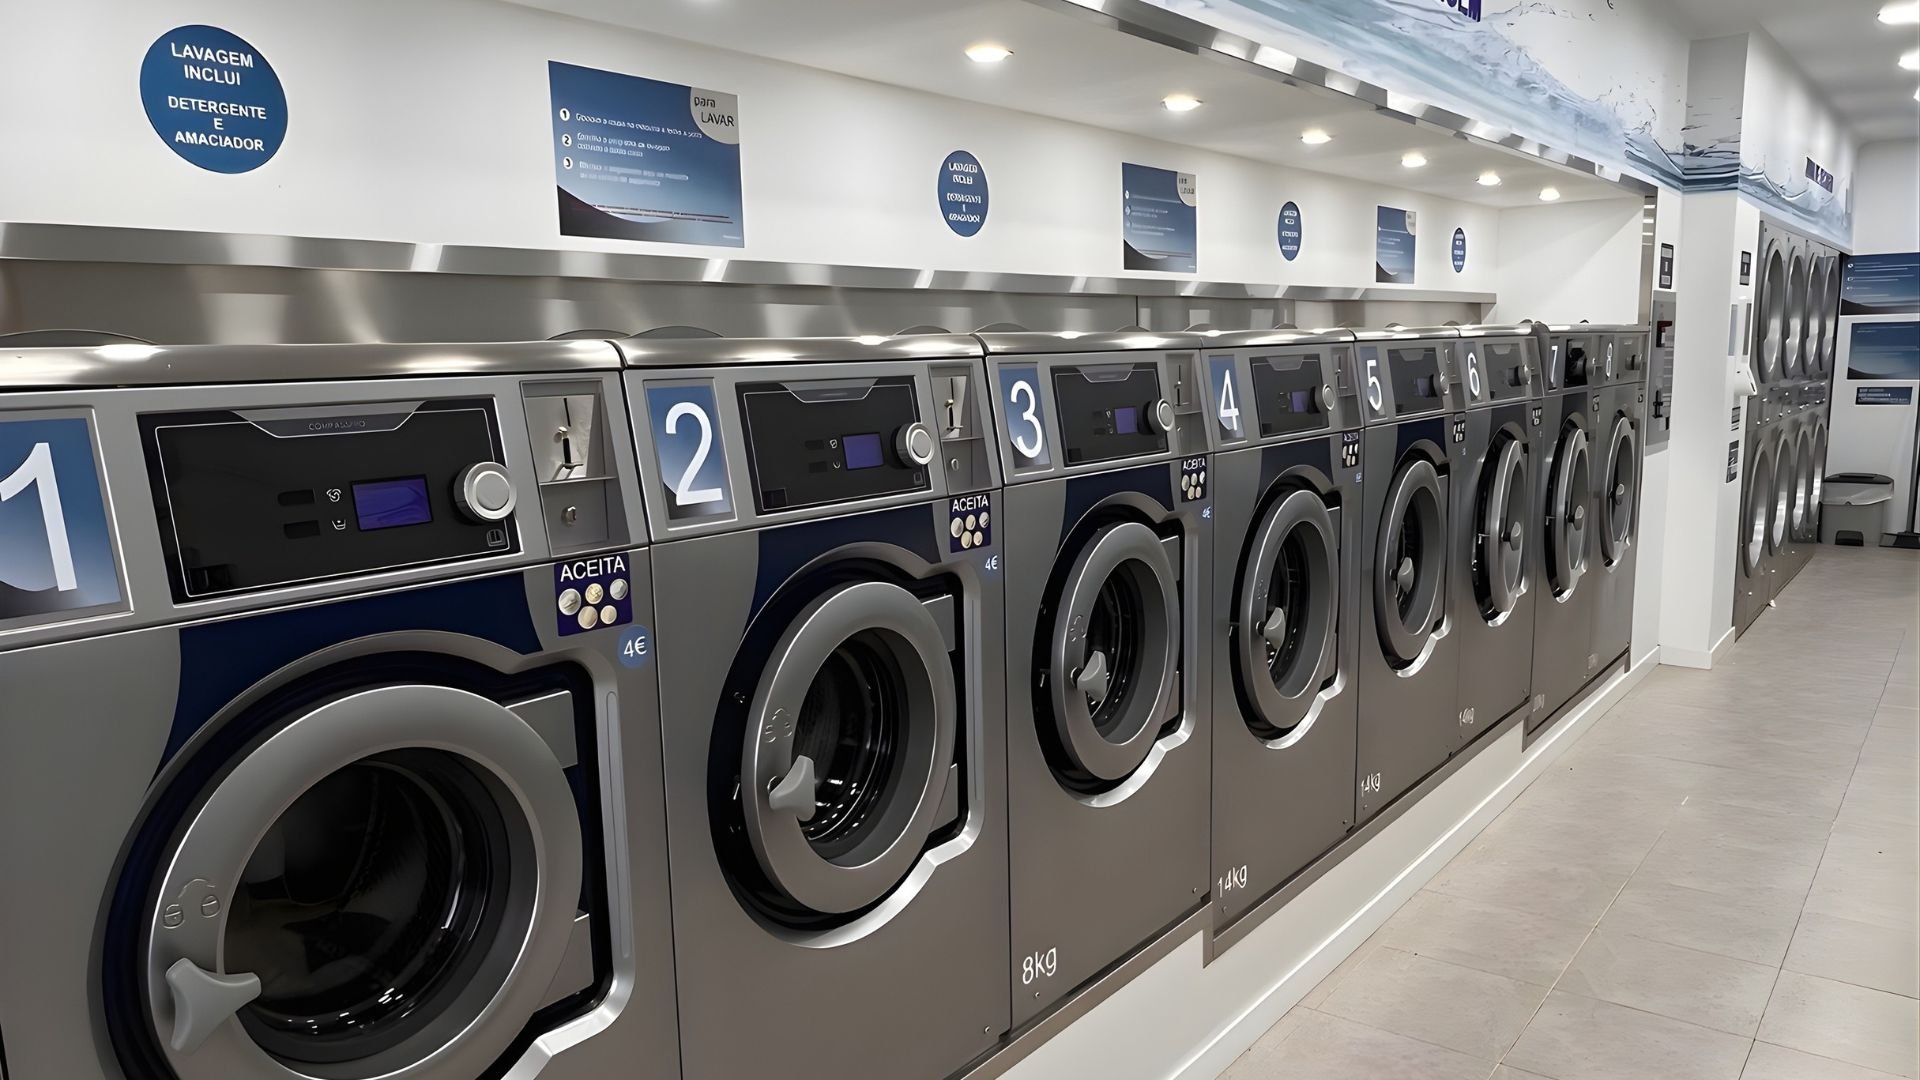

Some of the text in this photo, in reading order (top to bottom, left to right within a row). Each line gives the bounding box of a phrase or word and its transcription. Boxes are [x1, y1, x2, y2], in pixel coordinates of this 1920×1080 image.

[171, 42, 254, 68] LAVAGEM
[184, 65, 241, 85] INCLUI
[168, 95, 267, 119] DETERGENTE
[694, 96, 716, 109] para
[213, 118, 224, 130] E
[701, 112, 735, 127] LAVAR
[175, 131, 265, 151] AMACIADOR
[1605, 342, 1613, 378] 8
[1366, 360, 1383, 411] 5
[1467, 352, 1482, 397] 6
[1220, 369, 1240, 431] 4
[1010, 380, 1043, 458] 3
[665, 402, 724, 506] 2
[952, 494, 989, 513] ACEITA
[0, 443, 78, 592] 1
[560, 555, 626, 582] ACEITA
[985, 555, 998, 571] 4€
[624, 636, 647, 657] 4€
[1217, 864, 1248, 898] 14kg
[1022, 946, 1057, 985] 8kg
